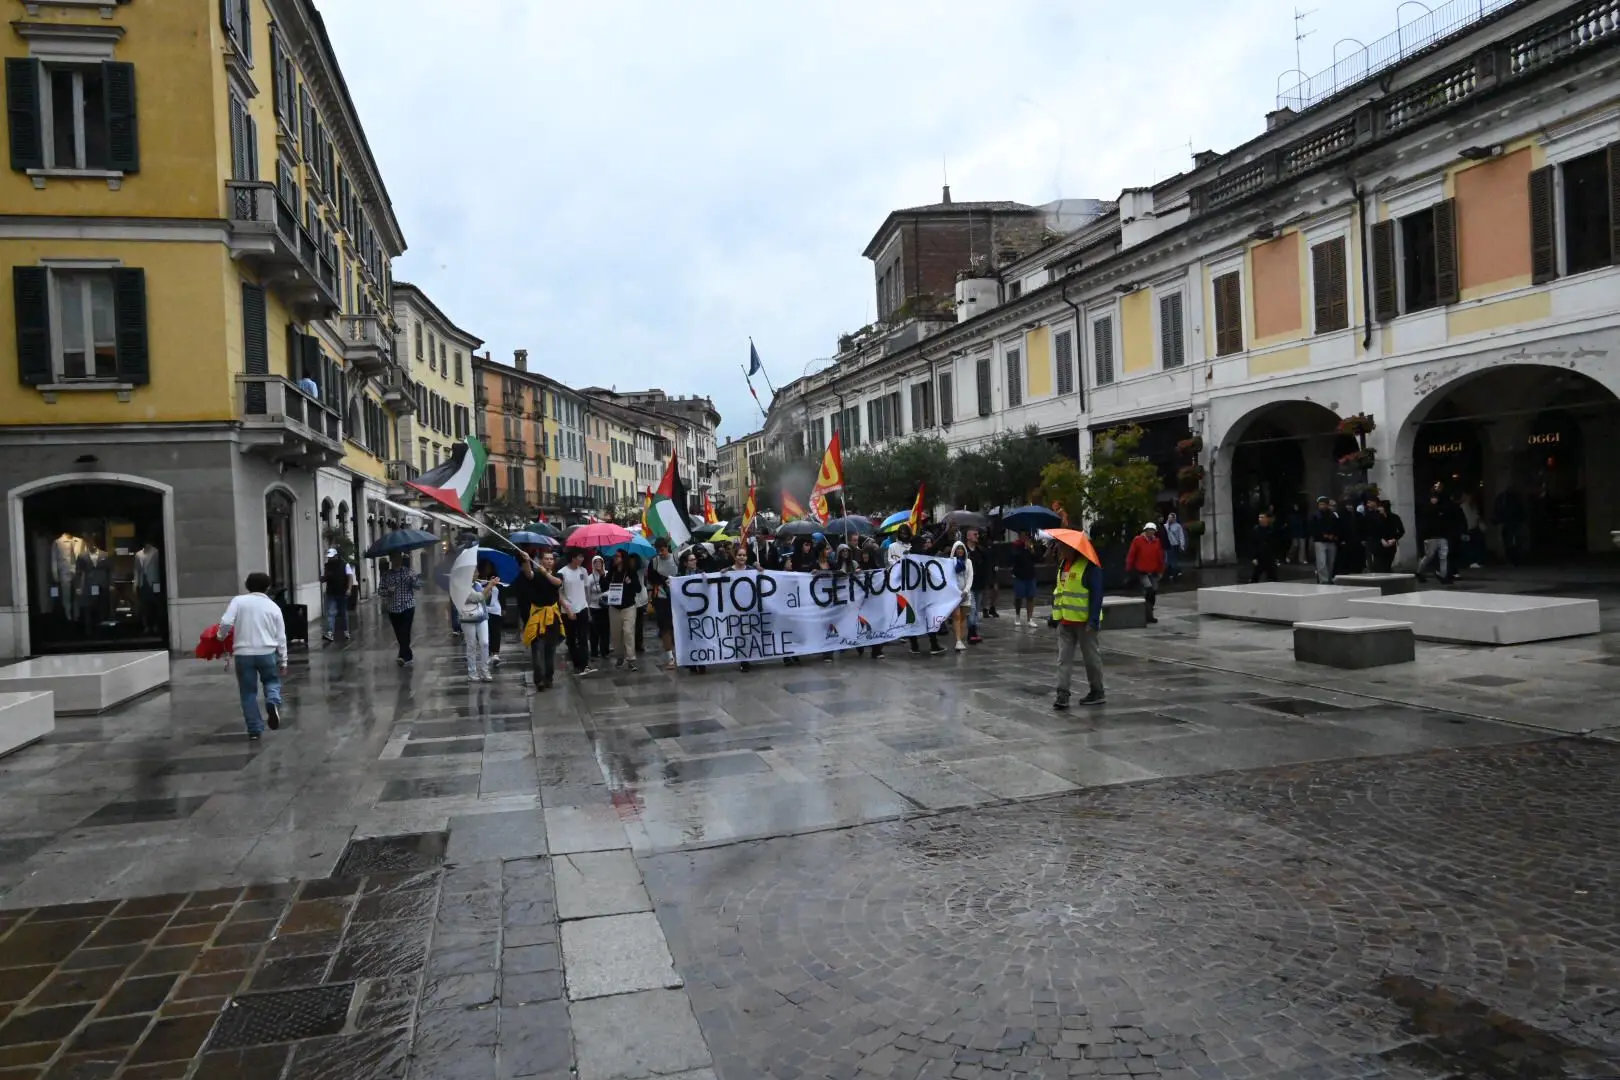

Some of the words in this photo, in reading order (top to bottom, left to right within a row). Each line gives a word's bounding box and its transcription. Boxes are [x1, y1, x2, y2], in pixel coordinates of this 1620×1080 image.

[1429, 442, 1462, 454] BOGGI
[1528, 432, 1560, 444] OGGI
[682, 575, 777, 616] STOP
[787, 585, 801, 608] al
[810, 558, 947, 608] GENOCIDIO
[688, 612, 772, 641] ROMPERE
[690, 648, 715, 662] con
[719, 631, 794, 660] ISRAELE
